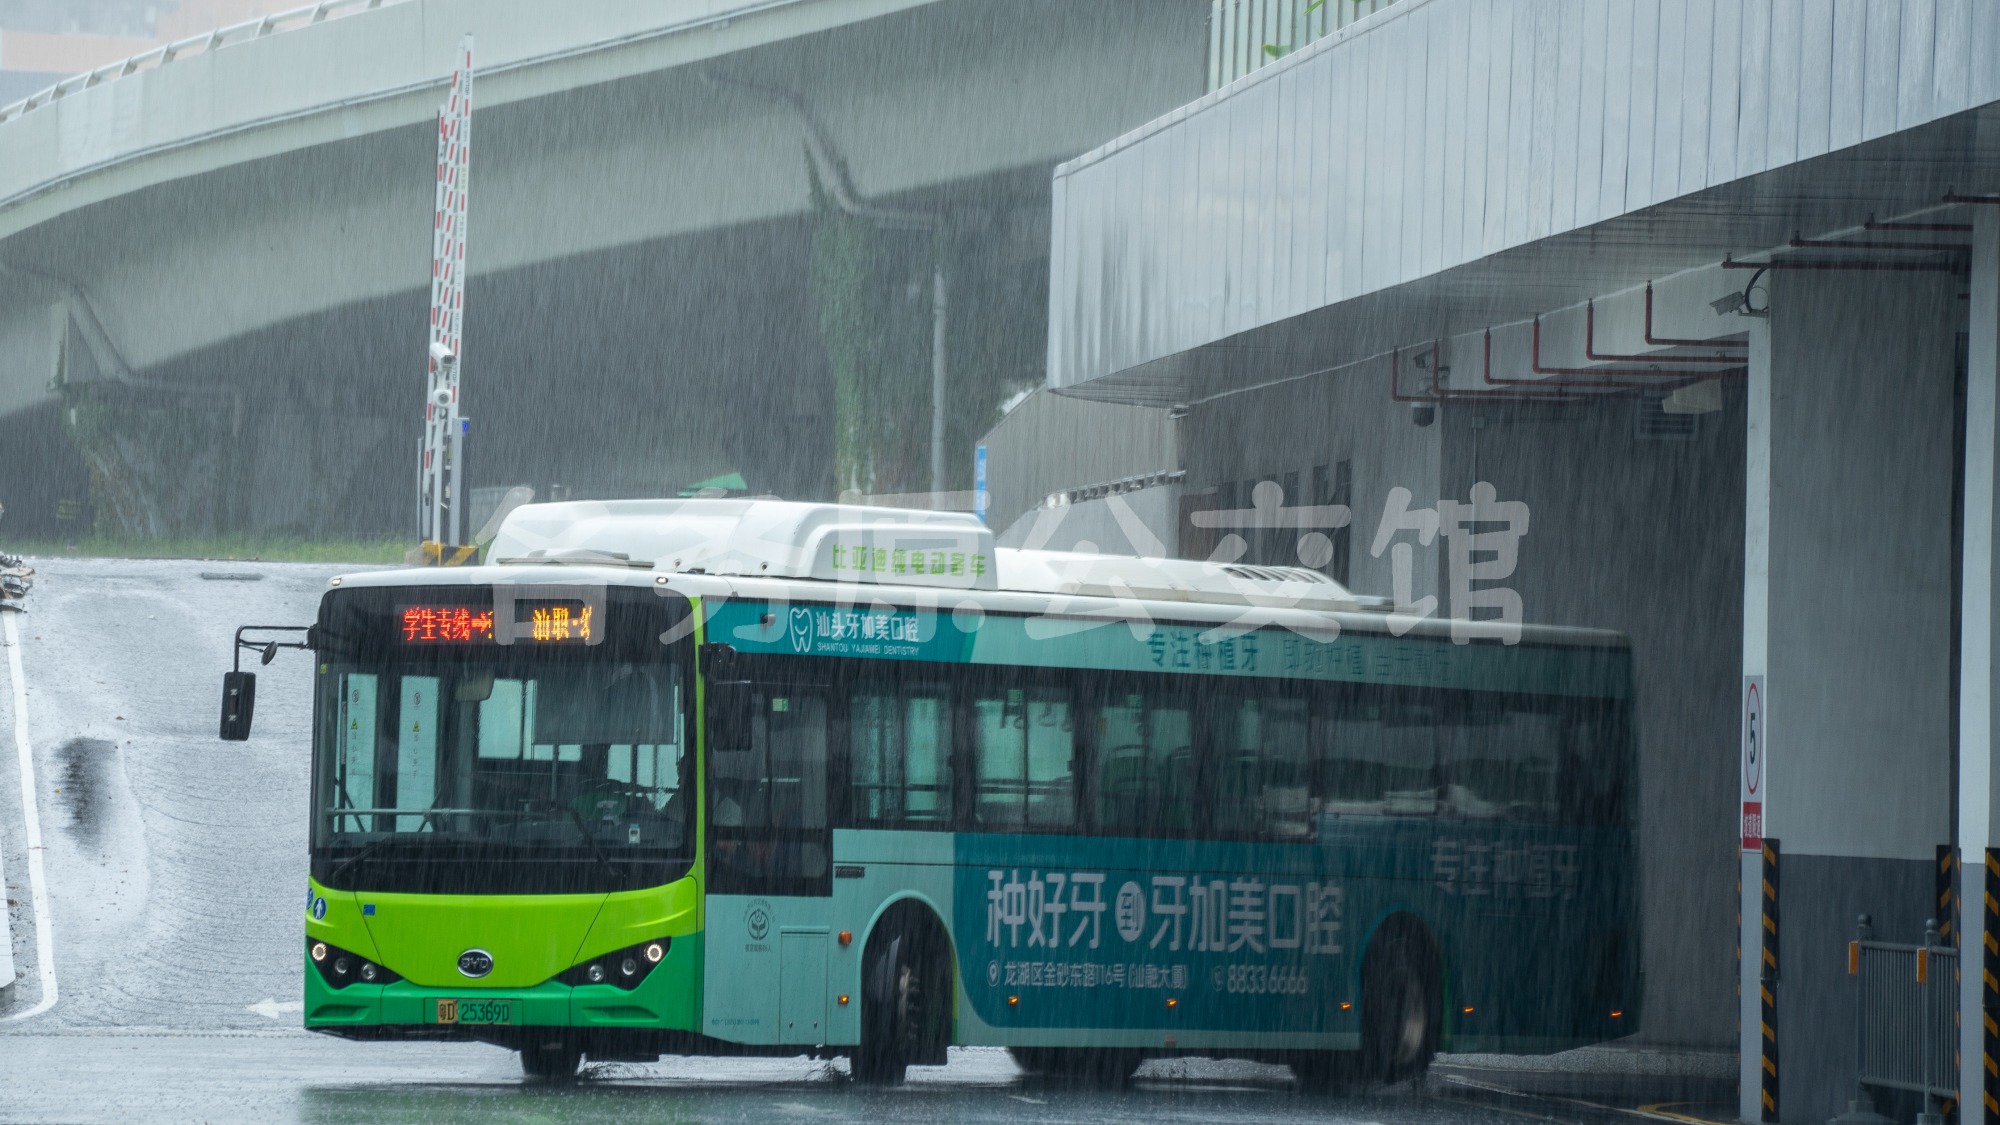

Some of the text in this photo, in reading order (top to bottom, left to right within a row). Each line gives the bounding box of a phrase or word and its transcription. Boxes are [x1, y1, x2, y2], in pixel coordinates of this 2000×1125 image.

[831, 543, 987, 578] 比亚迪纯电动客车
[816, 611, 920, 642] 汕头牙加美口腔
[816, 642, 920, 656] SHANTOU YAJIAMEI DENTISTRY
[460, 956, 490, 970] BYD
